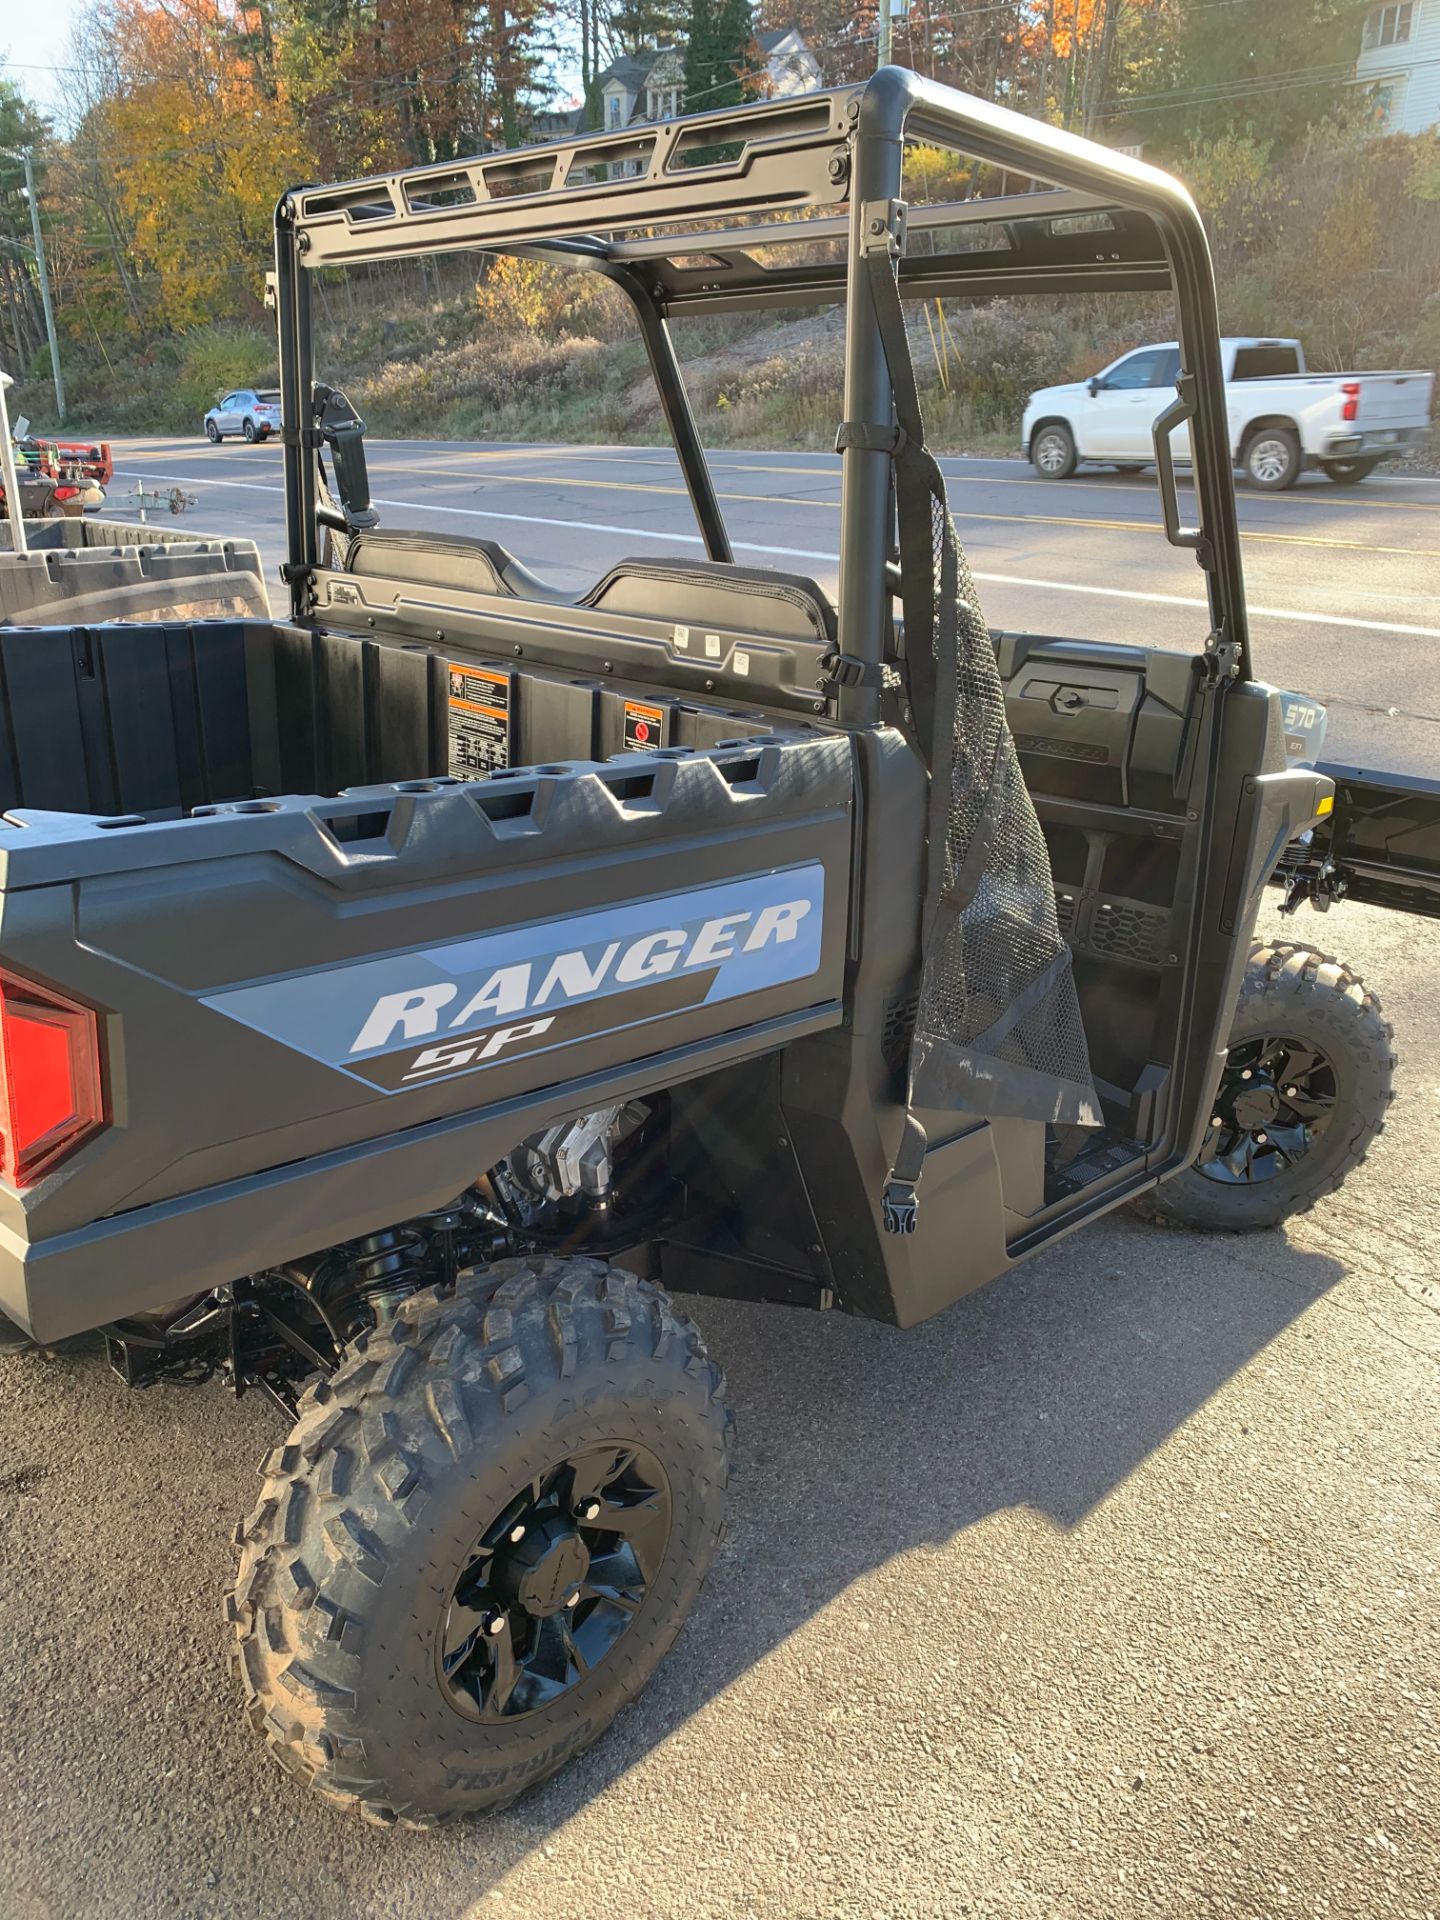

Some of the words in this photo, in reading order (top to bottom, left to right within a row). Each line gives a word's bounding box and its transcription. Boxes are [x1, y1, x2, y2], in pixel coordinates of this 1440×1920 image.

[1284, 703, 1316, 729] 570
[349, 899, 812, 1053] RANGER
[401, 1016, 556, 1081] SP
